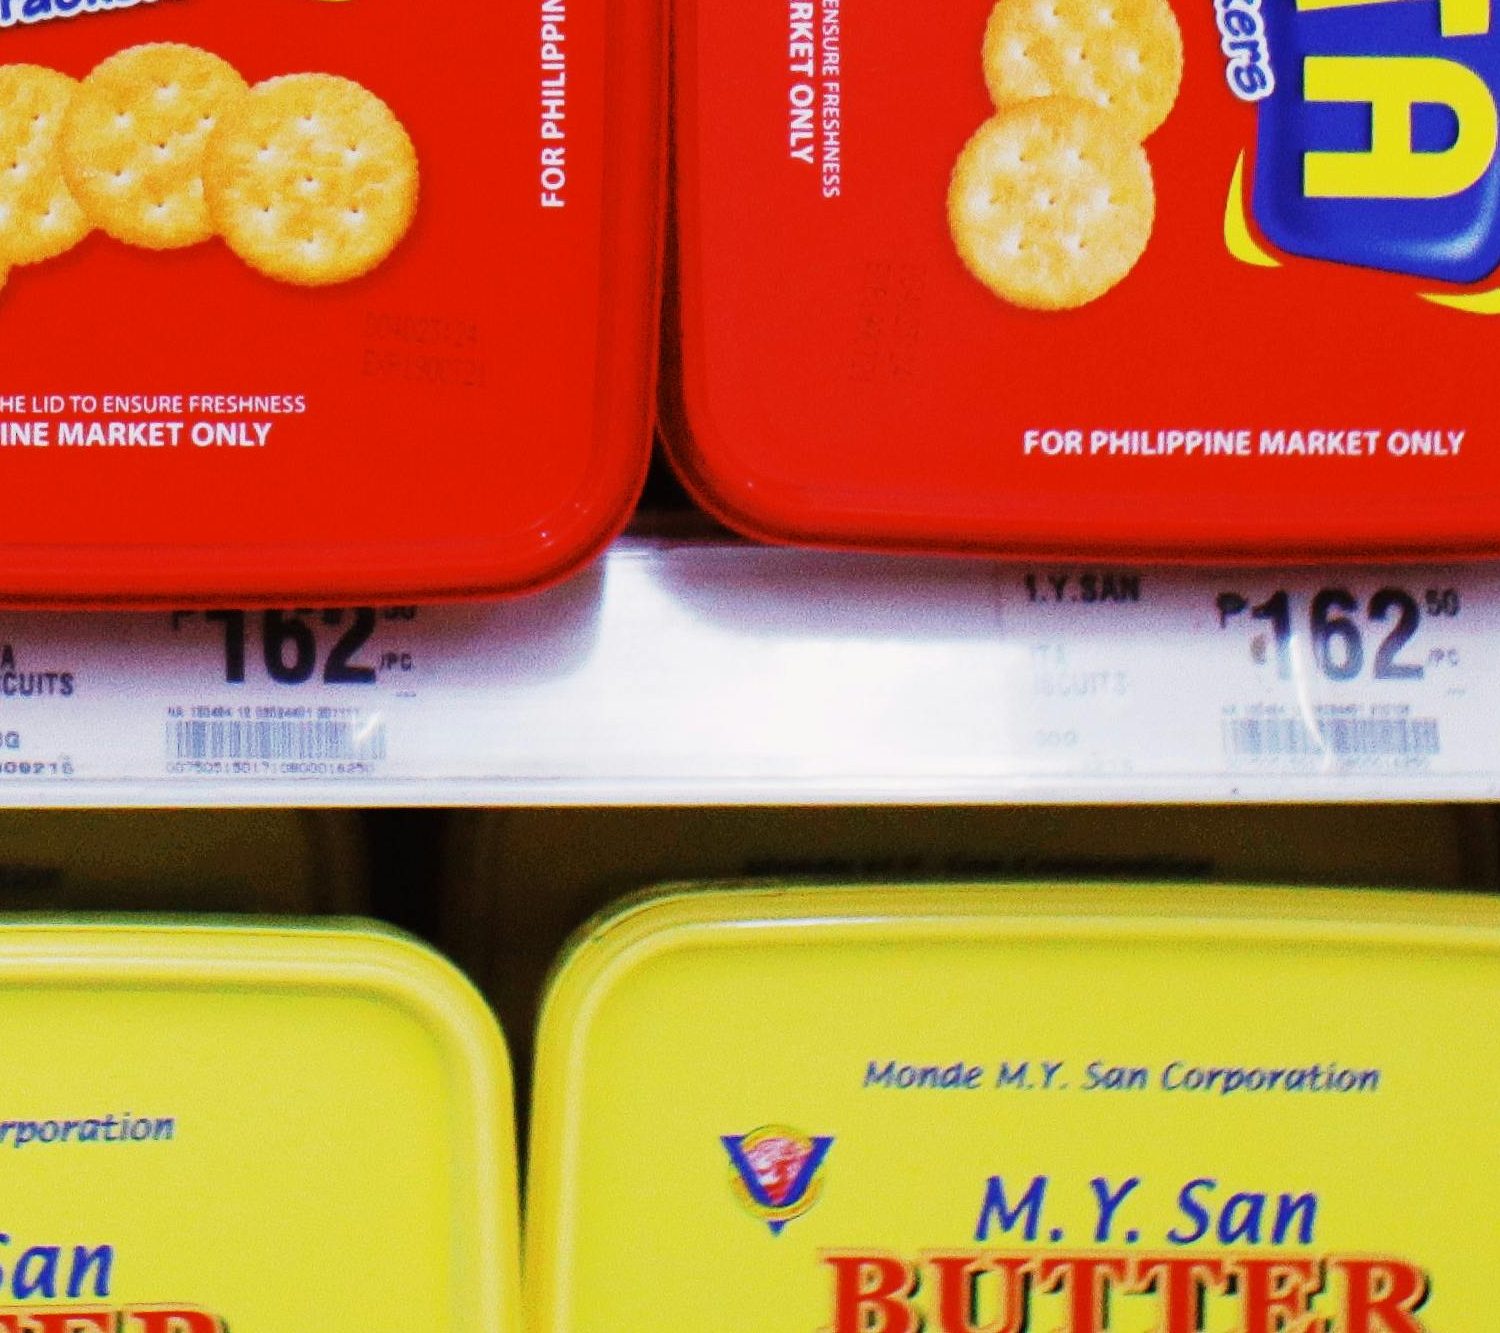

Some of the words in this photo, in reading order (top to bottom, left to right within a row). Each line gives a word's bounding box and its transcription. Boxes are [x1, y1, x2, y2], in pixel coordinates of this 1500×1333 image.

[32, 395, 65, 413] LID
[70, 395, 97, 413] TO
[103, 395, 182, 413] ENSURE
[189, 395, 305, 413] FRESHNESS
[58, 422, 183, 446] MARKET
[191, 422, 271, 446] ONLY
[1425, 588, 1464, 619] 50
[865, 1061, 983, 1089] Monde
[993, 1057, 1070, 1093] M.Y.
[1087, 1062, 1148, 1089] San
[1161, 1062, 1380, 1094] Corporation
[976, 1176, 1062, 1241] M.
[1091, 1178, 1139, 1242] Y.
[1167, 1179, 1317, 1244] San
